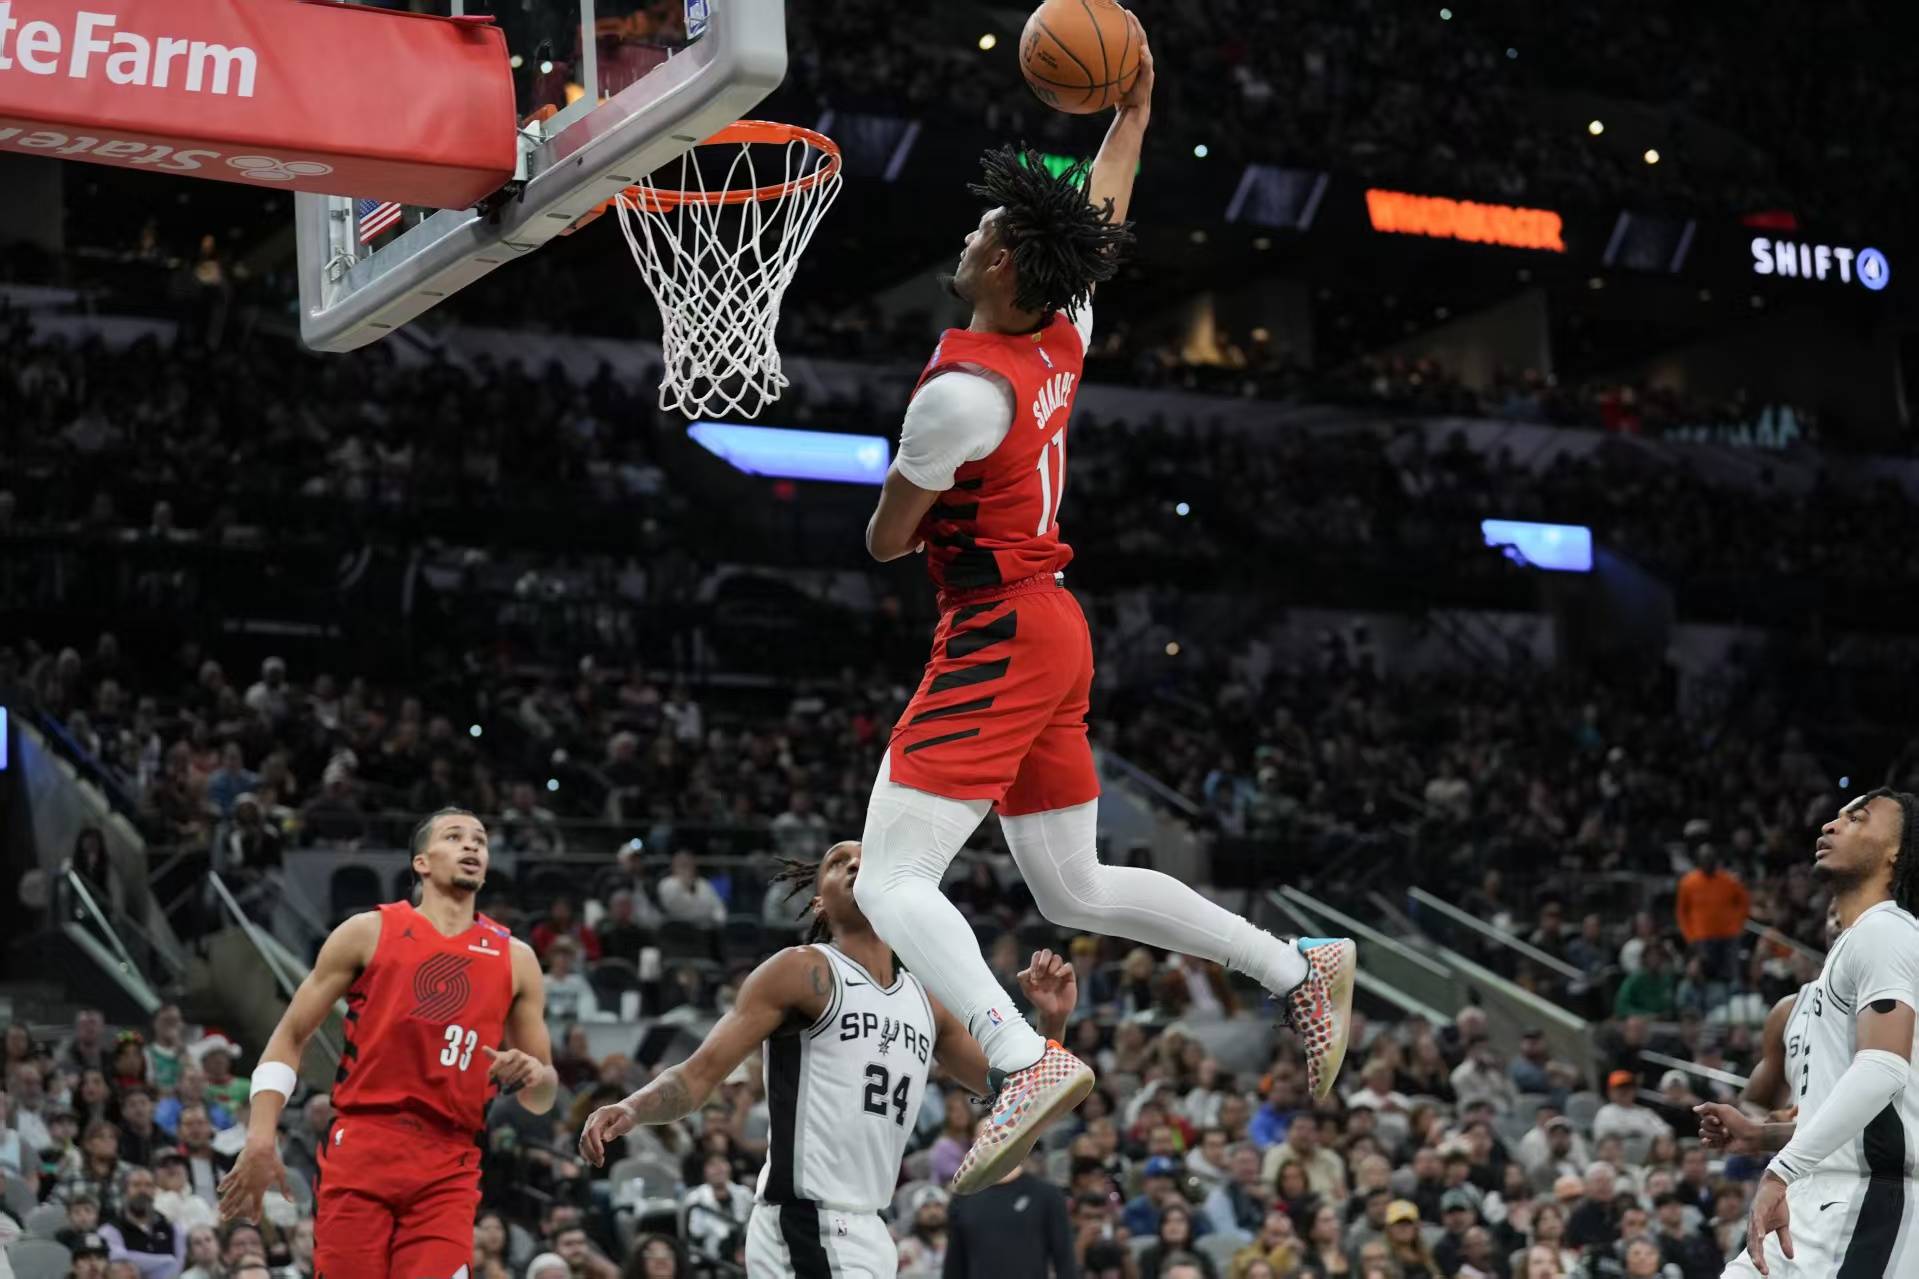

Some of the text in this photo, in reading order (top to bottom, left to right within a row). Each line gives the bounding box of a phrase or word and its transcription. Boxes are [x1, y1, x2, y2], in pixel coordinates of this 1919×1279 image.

[440, 1024, 479, 1072] 33
[840, 1012, 930, 1066] SPURS
[863, 1062, 912, 1128] 24
